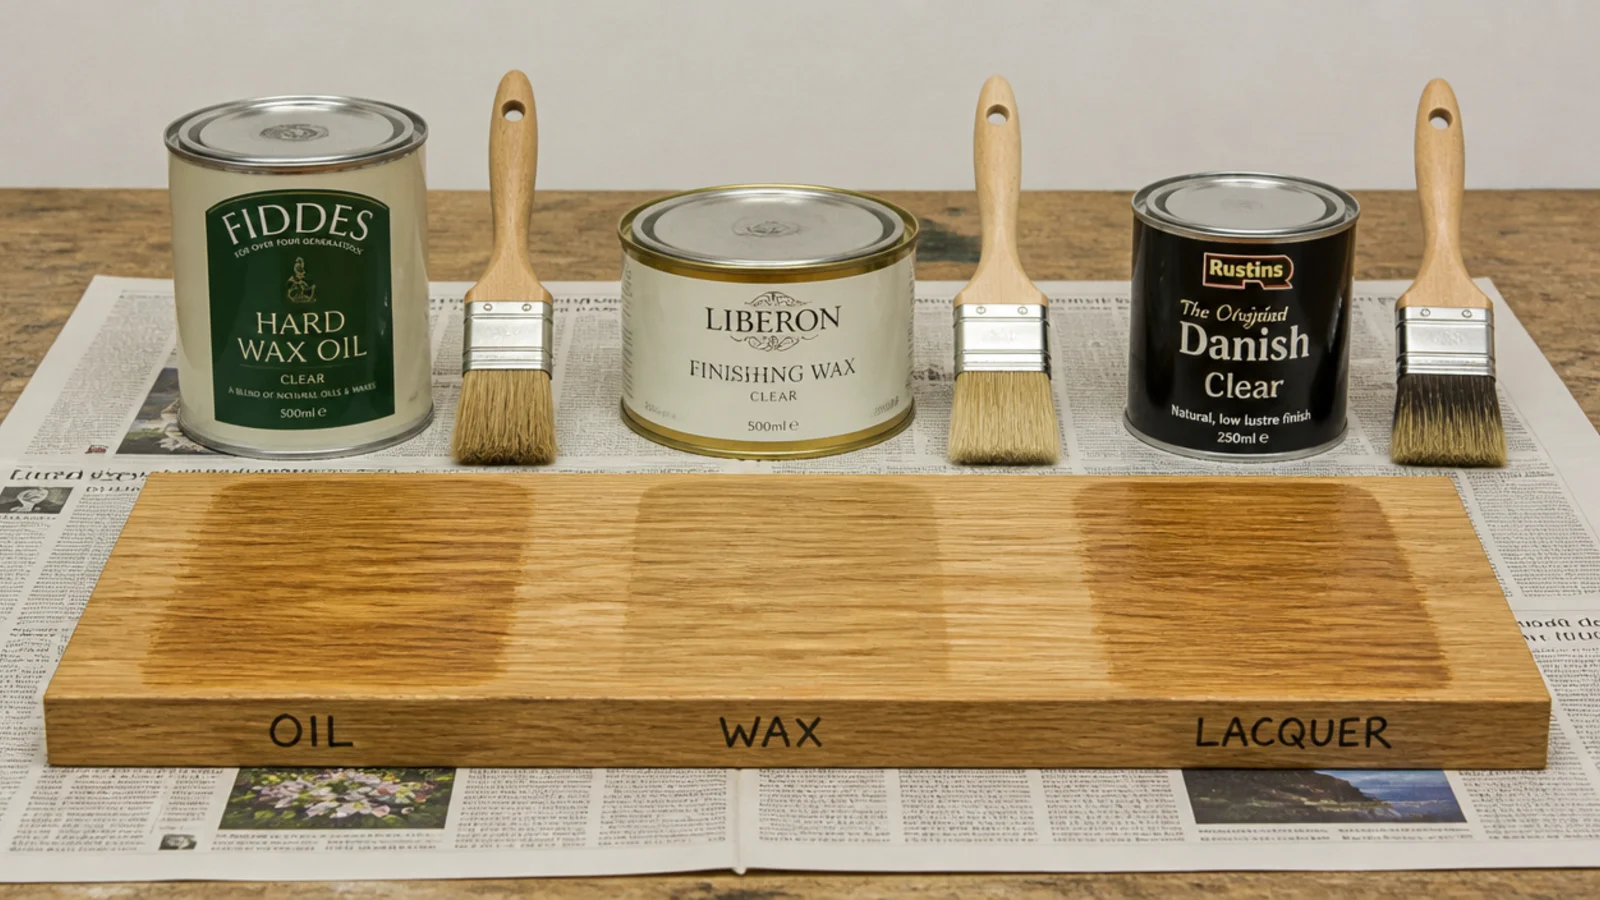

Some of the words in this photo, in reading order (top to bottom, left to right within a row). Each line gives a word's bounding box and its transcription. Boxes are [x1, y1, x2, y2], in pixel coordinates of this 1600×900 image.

[221, 202, 374, 246] FIDDES
[1208, 258, 1284, 279] Rustins
[704, 305, 842, 334] LIBERON
[1180, 299, 1210, 319] The
[256, 310, 346, 335] HARD
[237, 337, 308, 363] WAX
[317, 335, 368, 362] OIL
[1179, 320, 1310, 361] Danish
[280, 373, 325, 385] CLEAR
[690, 359, 804, 384] FINISHING
[810, 357, 856, 381] WAX
[749, 389, 798, 402] CLEAR
[1204, 371, 1285, 400] Clear
[280, 408, 315, 418] 500ml
[747, 420, 787, 432] 500ml
[1171, 403, 1216, 426] Natural,
[1219, 413, 1241, 426] low
[1244, 414, 1280, 427] lustre
[1282, 409, 1312, 425] finish
[1217, 431, 1256, 444] 250ml
[269, 713, 354, 748] OIL
[719, 716, 823, 748] WAX
[1195, 716, 1393, 750] LACQUER
